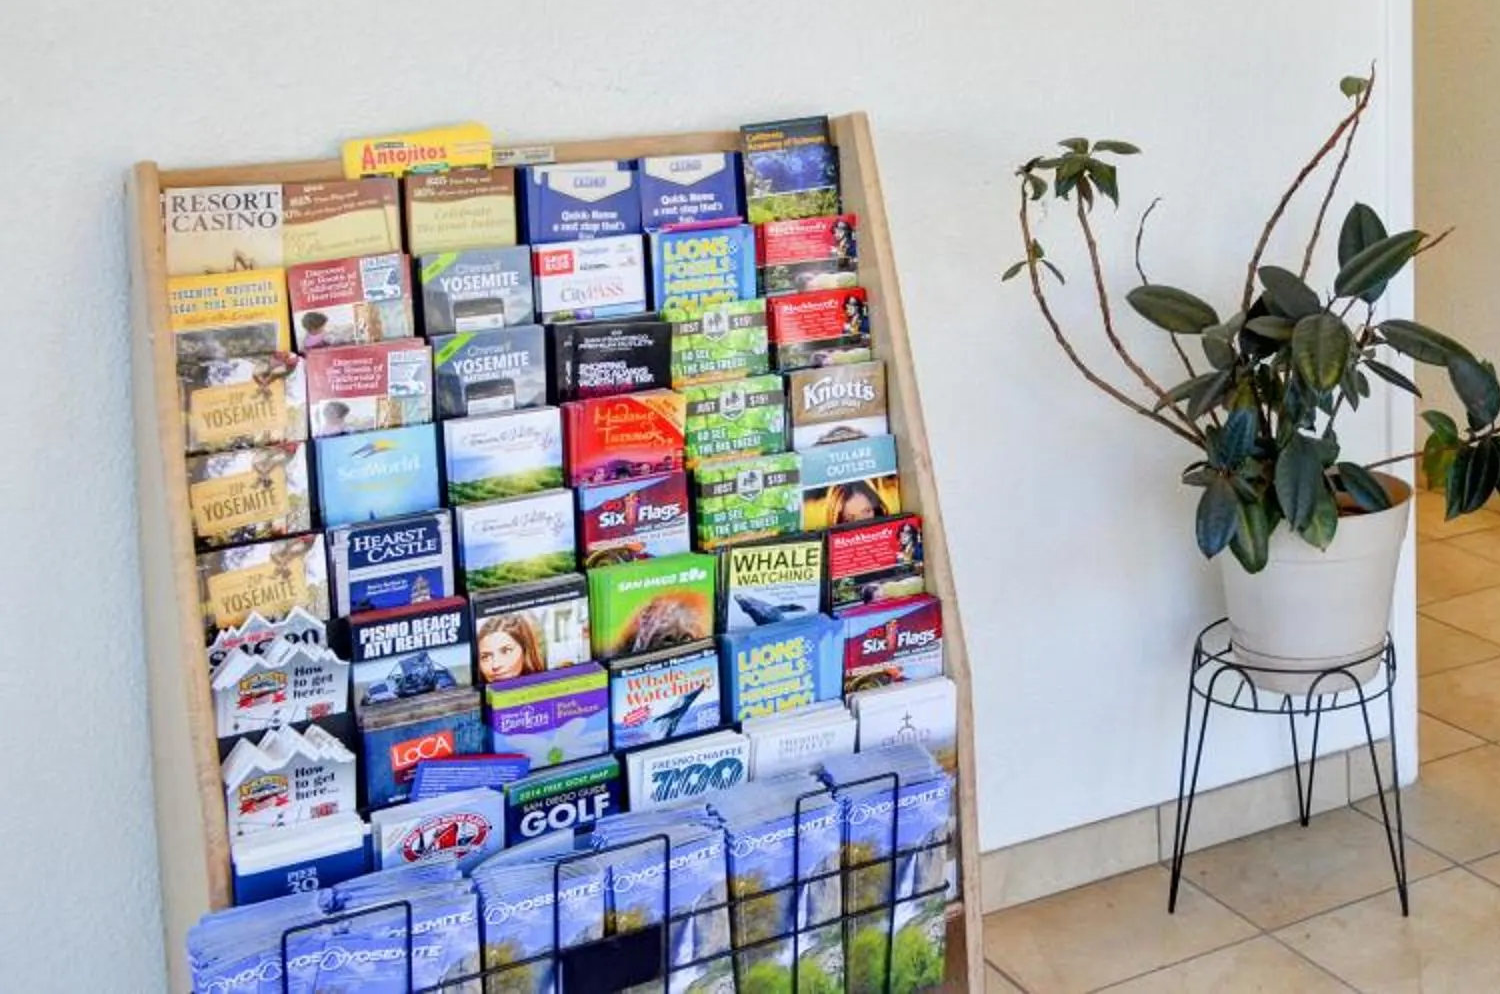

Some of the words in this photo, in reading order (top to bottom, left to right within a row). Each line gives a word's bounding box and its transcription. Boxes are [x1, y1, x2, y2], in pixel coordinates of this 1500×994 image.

[362, 143, 448, 171] Antojitos
[172, 191, 279, 213] RESORT
[172, 211, 277, 233] CASINO
[440, 271, 519, 293] YOSEMITE
[453, 351, 529, 375] YOSEMITE
[802, 376, 876, 411] Knott's
[202, 403, 278, 429] YOSEMITE
[826, 460, 876, 478] OUTLETS
[202, 487, 277, 521] YOSEMITE
[600, 510, 626, 529] Six
[639, 503, 681, 523] Flags
[353, 527, 428, 553] HEARST
[367, 537, 438, 563] CASTLE
[733, 547, 820, 573] WHALE
[736, 568, 815, 586] WATCHING
[221, 580, 298, 614] YOSEMITE
[360, 623, 409, 645] PISMO
[411, 612, 461, 633] BEACH
[862, 637, 887, 655] Six
[897, 628, 936, 646] Flags
[364, 641, 394, 659] ATV
[395, 628, 459, 653] RENTALS
[294, 664, 324, 677] How
[294, 677, 308, 688] to
[311, 673, 334, 686] get
[627, 669, 685, 691] Whale
[626, 677, 713, 706] Watching
[295, 765, 325, 778] How
[295, 778, 309, 789] to
[312, 773, 335, 786] get
[651, 757, 744, 803] ZOO
[545, 791, 576, 806] DIEGO
[520, 792, 611, 838] GOLF
